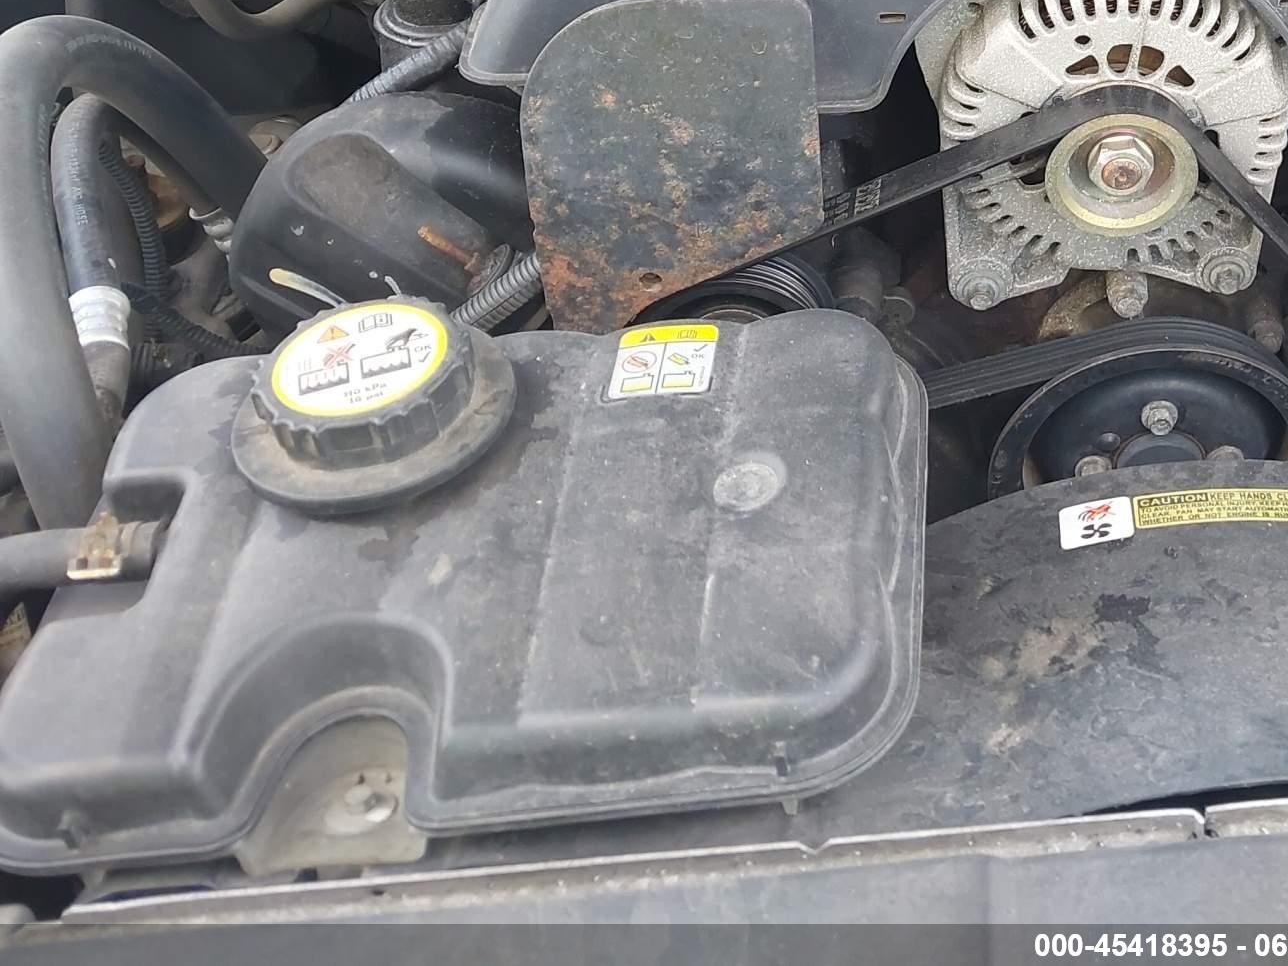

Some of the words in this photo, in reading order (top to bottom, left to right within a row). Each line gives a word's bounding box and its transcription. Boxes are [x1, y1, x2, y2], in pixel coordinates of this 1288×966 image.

[1140, 494, 1207, 507] CAUTION
[1209, 492, 1235, 501] KEEP
[1239, 492, 1273, 500] HANDS
[1180, 500, 1224, 509] PERSONAL
[1141, 515, 1184, 525] WHETHER
